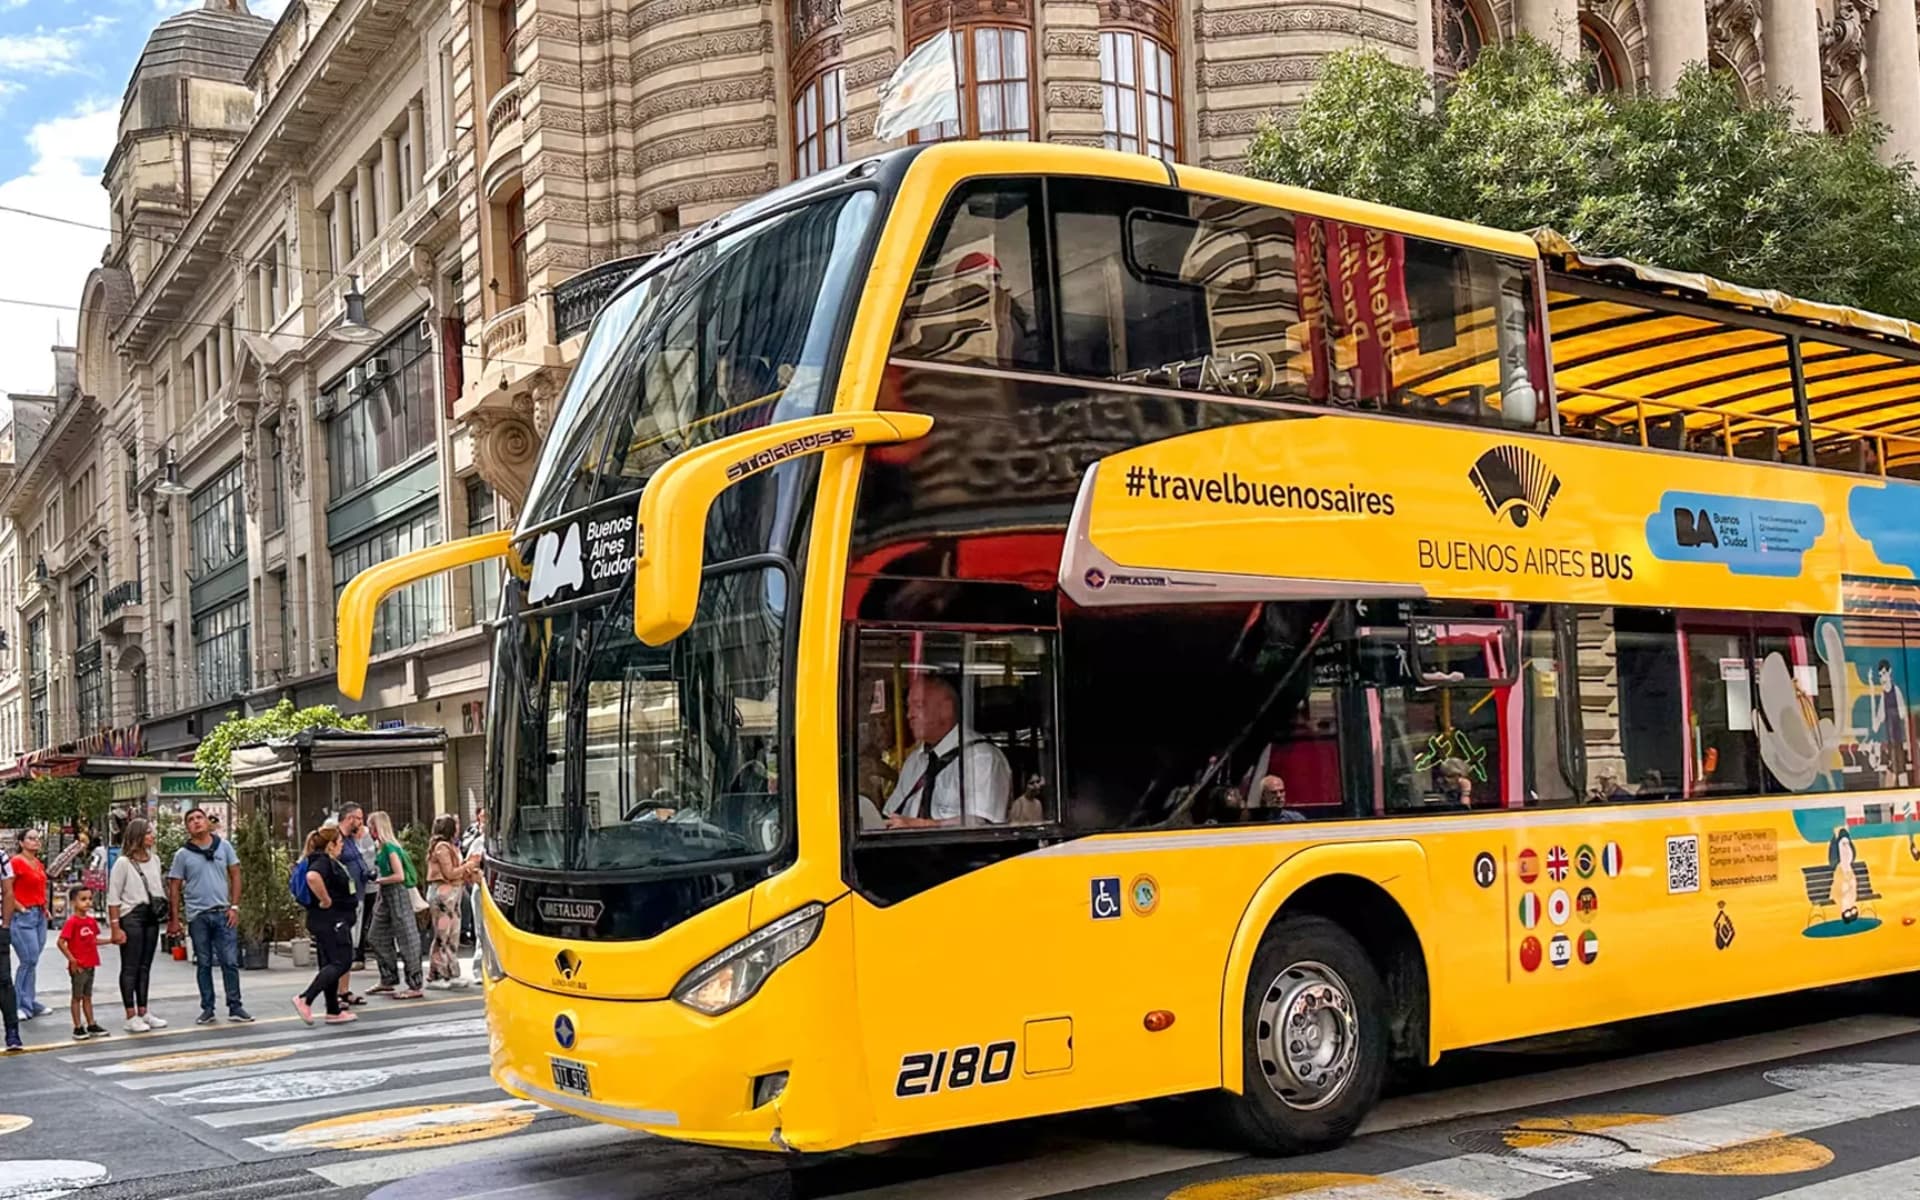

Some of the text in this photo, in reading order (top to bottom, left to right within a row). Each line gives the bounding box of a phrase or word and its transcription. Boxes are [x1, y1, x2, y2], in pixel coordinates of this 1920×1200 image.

[1126, 465, 1395, 516] #travelbuenosaires
[586, 515, 634, 541] Buenos
[1674, 507, 1719, 549] BA
[1713, 512, 1740, 525] Buenos
[1719, 527, 1740, 536] Aires
[1722, 536, 1748, 548] Ciudad
[590, 538, 626, 561] Aires
[1418, 539, 1633, 581] BUENOS AIRES BUS
[543, 902, 596, 919] METALSUR
[895, 1041, 1016, 1098] 2180
